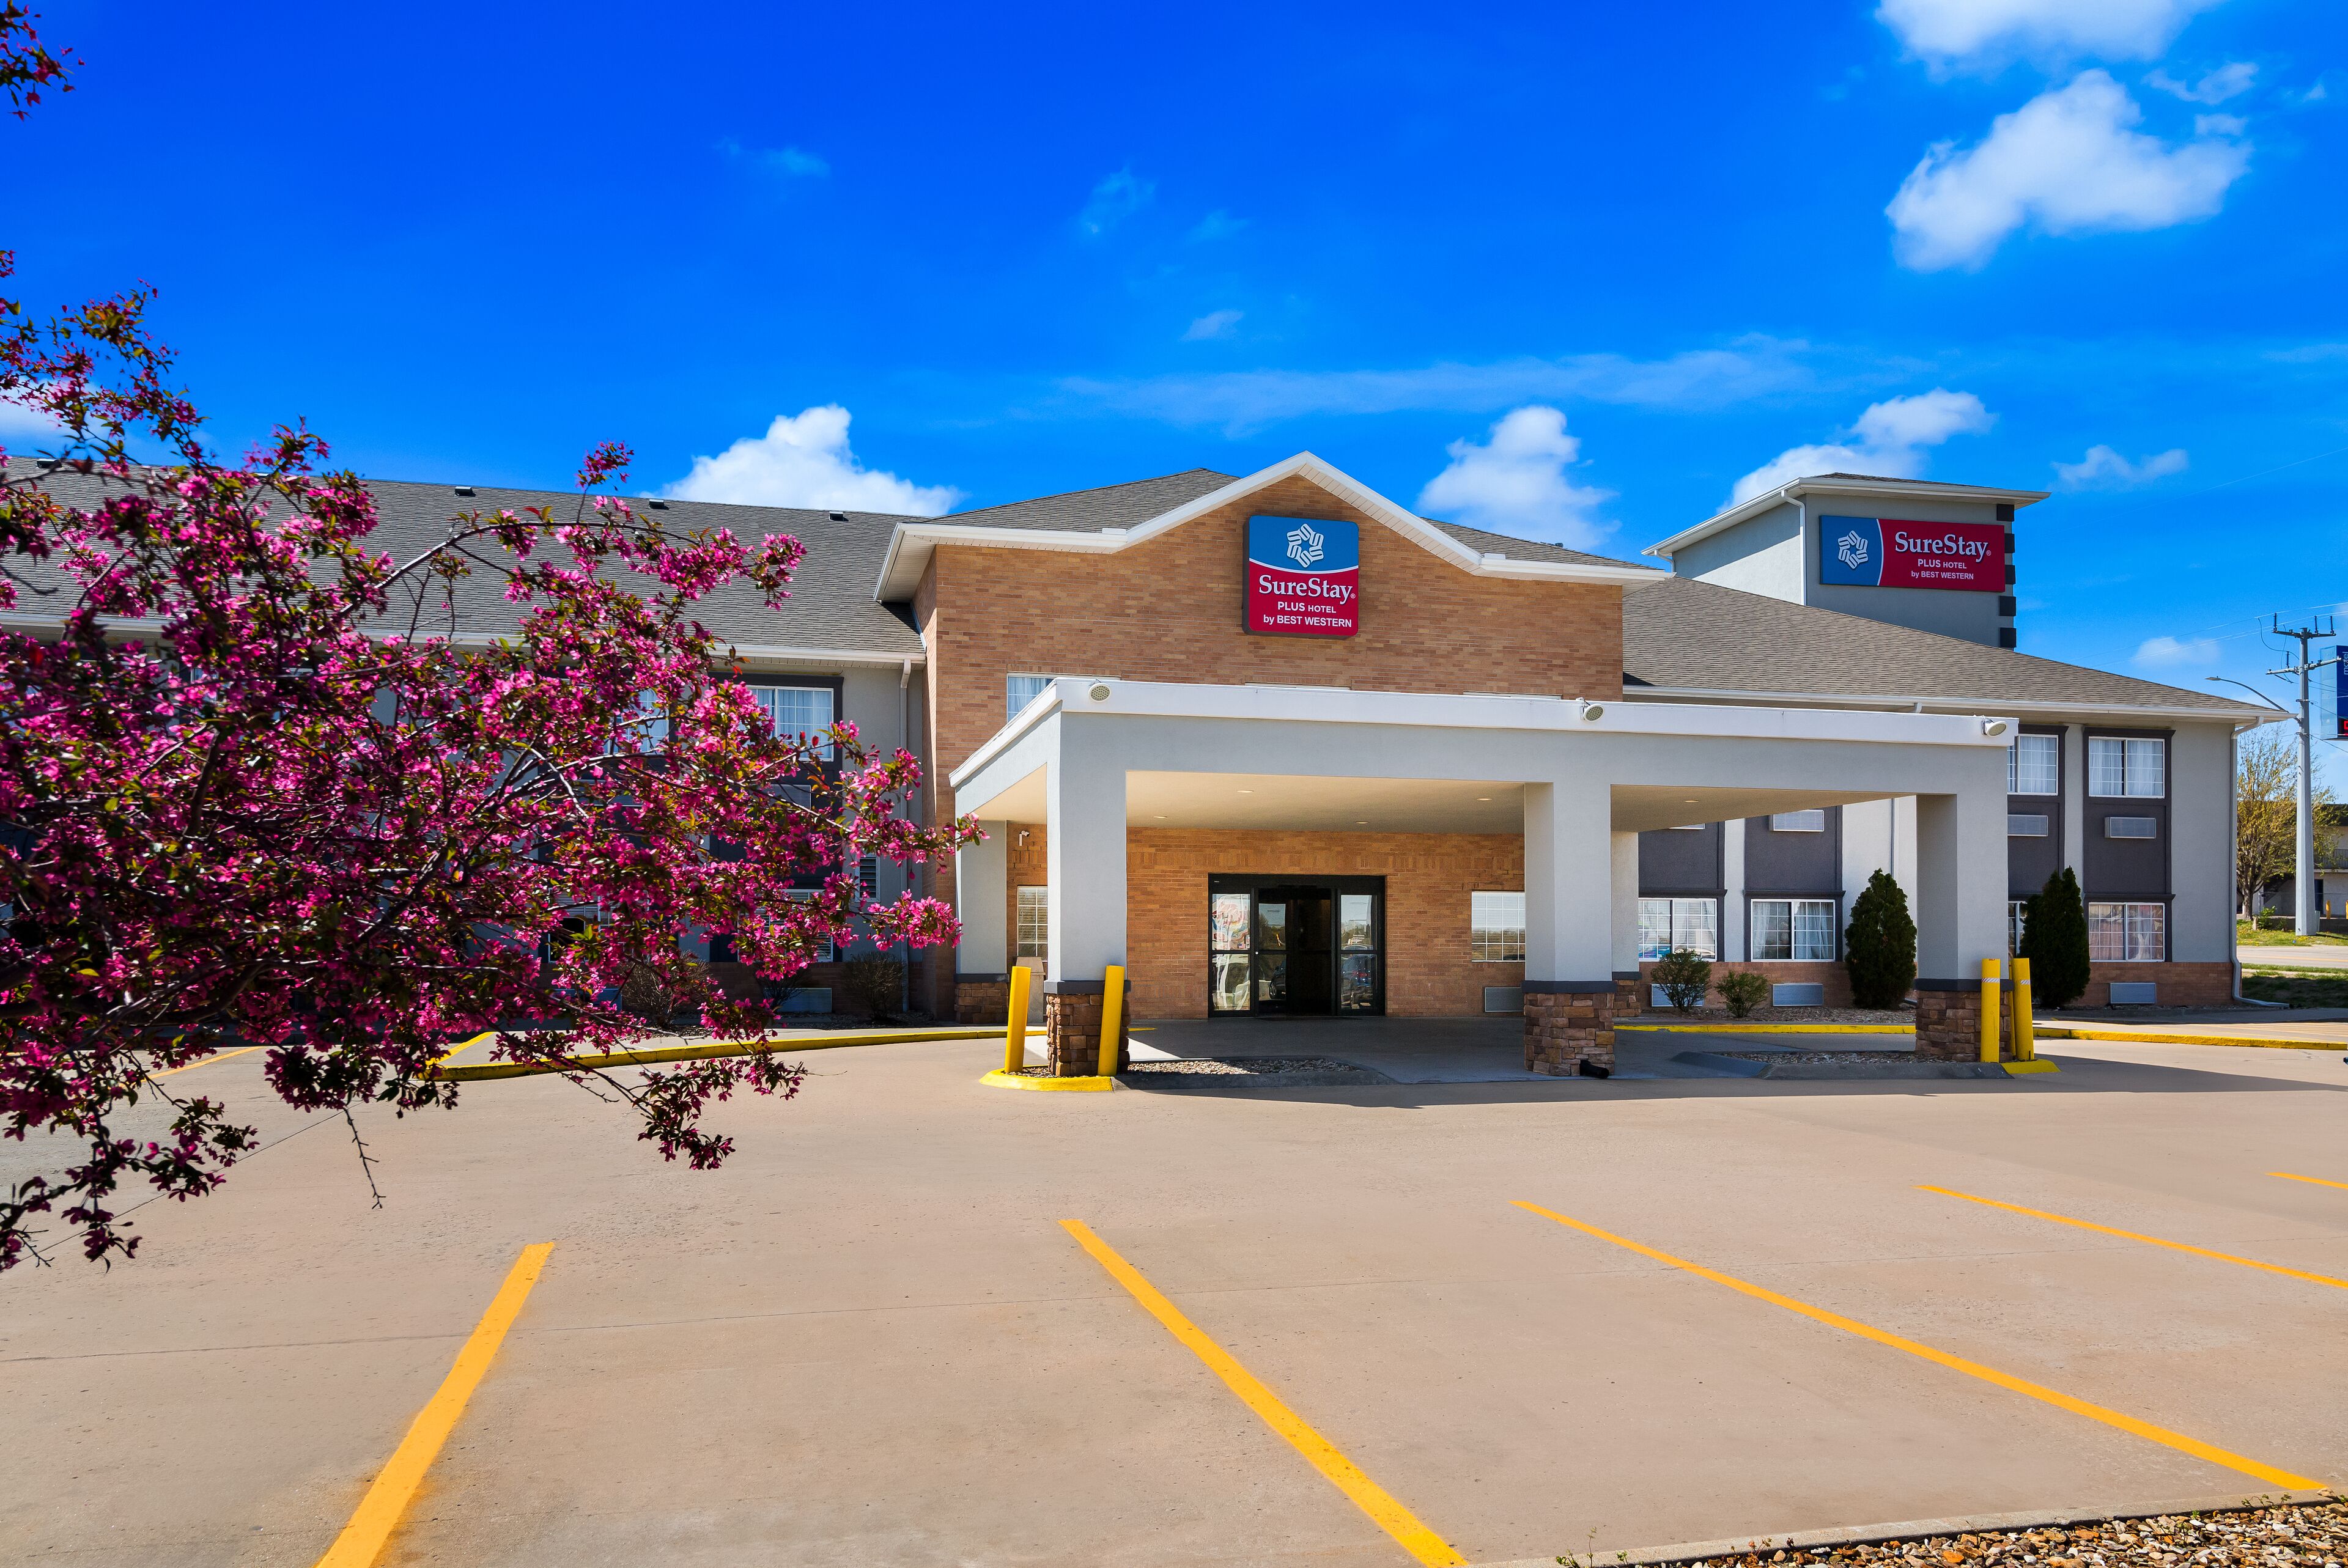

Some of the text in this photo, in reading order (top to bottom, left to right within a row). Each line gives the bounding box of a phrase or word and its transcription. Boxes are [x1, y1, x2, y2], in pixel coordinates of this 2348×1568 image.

[1918, 559, 1941, 568] PLUS
[1911, 570, 1919, 579] by
[1941, 572, 1974, 580] WESTERN
[1277, 601, 1337, 613] PLUS HOTEL
[1263, 614, 1352, 628] by BEST WESTERN
